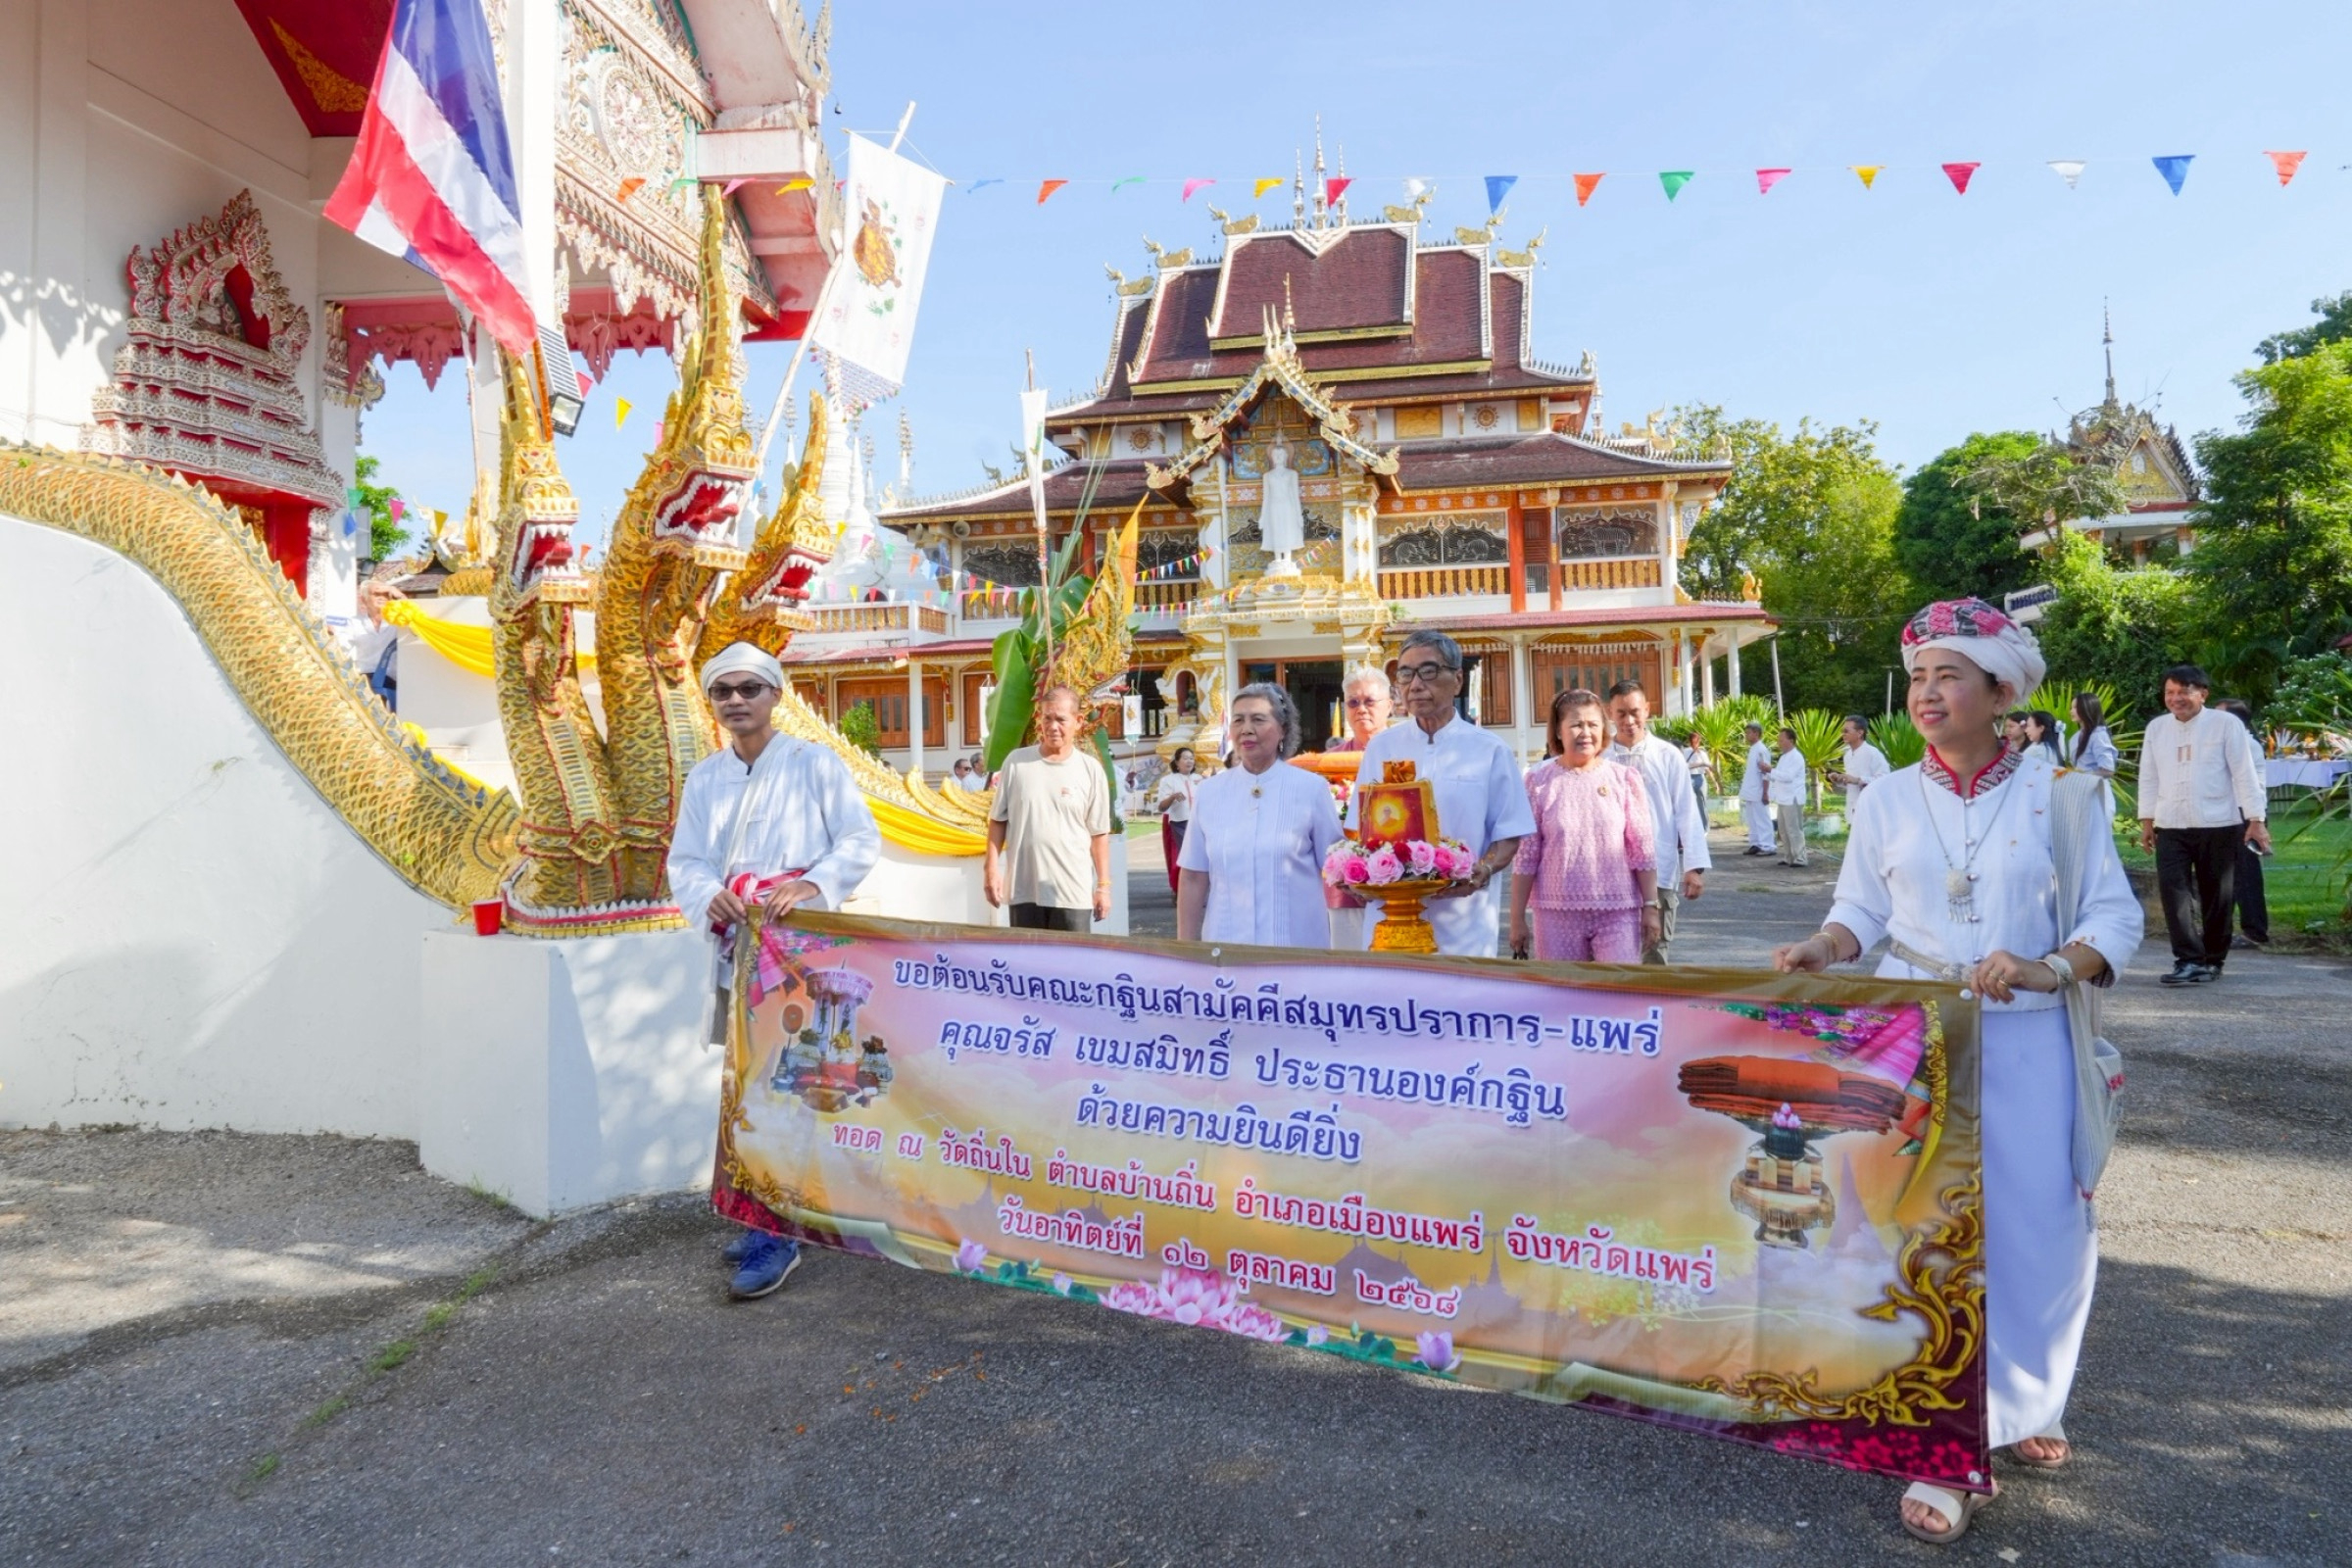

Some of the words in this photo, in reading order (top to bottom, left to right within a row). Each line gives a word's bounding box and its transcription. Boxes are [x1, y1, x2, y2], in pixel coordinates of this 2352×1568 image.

[894, 954, 1661, 1054] ขอต้อนรับคณะกฐินสามัคคีสมุทรปราการ-แพร่
[940, 1015, 1056, 1060] คุณจรัส
[1074, 1029, 1232, 1076] เขมสมิทธิ์
[1255, 1049, 1566, 1124] ประธานองค์กฐิน
[1077, 1084, 1361, 1161] ด้วยความยินดียิ่ง
[833, 1122, 883, 1149] ทอด
[898, 1132, 921, 1157] ณ
[940, 1129, 1031, 1178] วัดถิ่นใน
[1048, 1151, 1215, 1209] ตำบลบ้านถิ่น
[1236, 1179, 1483, 1250] อำเภอเมืองแพร่
[1507, 1215, 1715, 1290] จังหวัดแพร่
[999, 1195, 1144, 1256] วันอาทิตย์ที่
[1163, 1239, 1207, 1269] ๑๒
[1230, 1250, 1335, 1293] ตุลาคม
[1355, 1271, 1460, 1316] ๒๕๖๘
